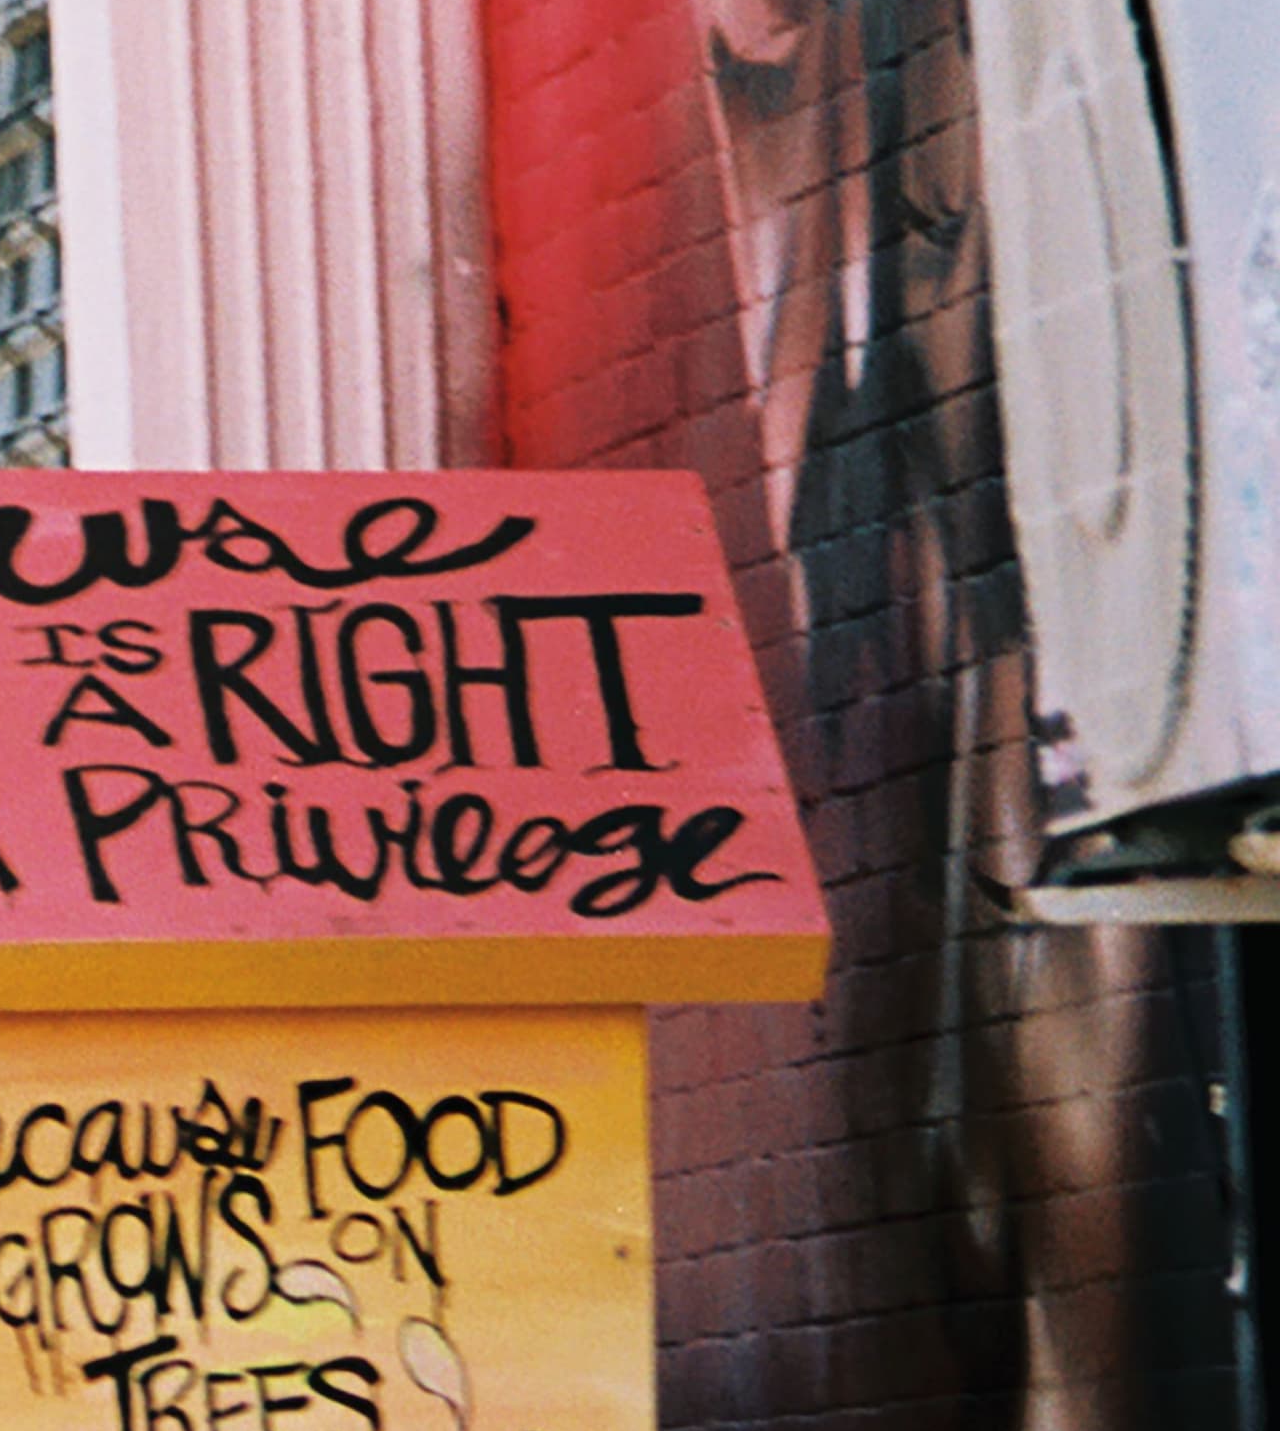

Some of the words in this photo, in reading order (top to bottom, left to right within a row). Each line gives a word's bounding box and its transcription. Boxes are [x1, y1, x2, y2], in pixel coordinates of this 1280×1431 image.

[22, 619, 166, 677] IS
[187, 592, 706, 773] RIGHT
[41, 673, 172, 747] A
[298, 1076, 567, 1220] FOOD
[329, 1199, 448, 1291] ON
